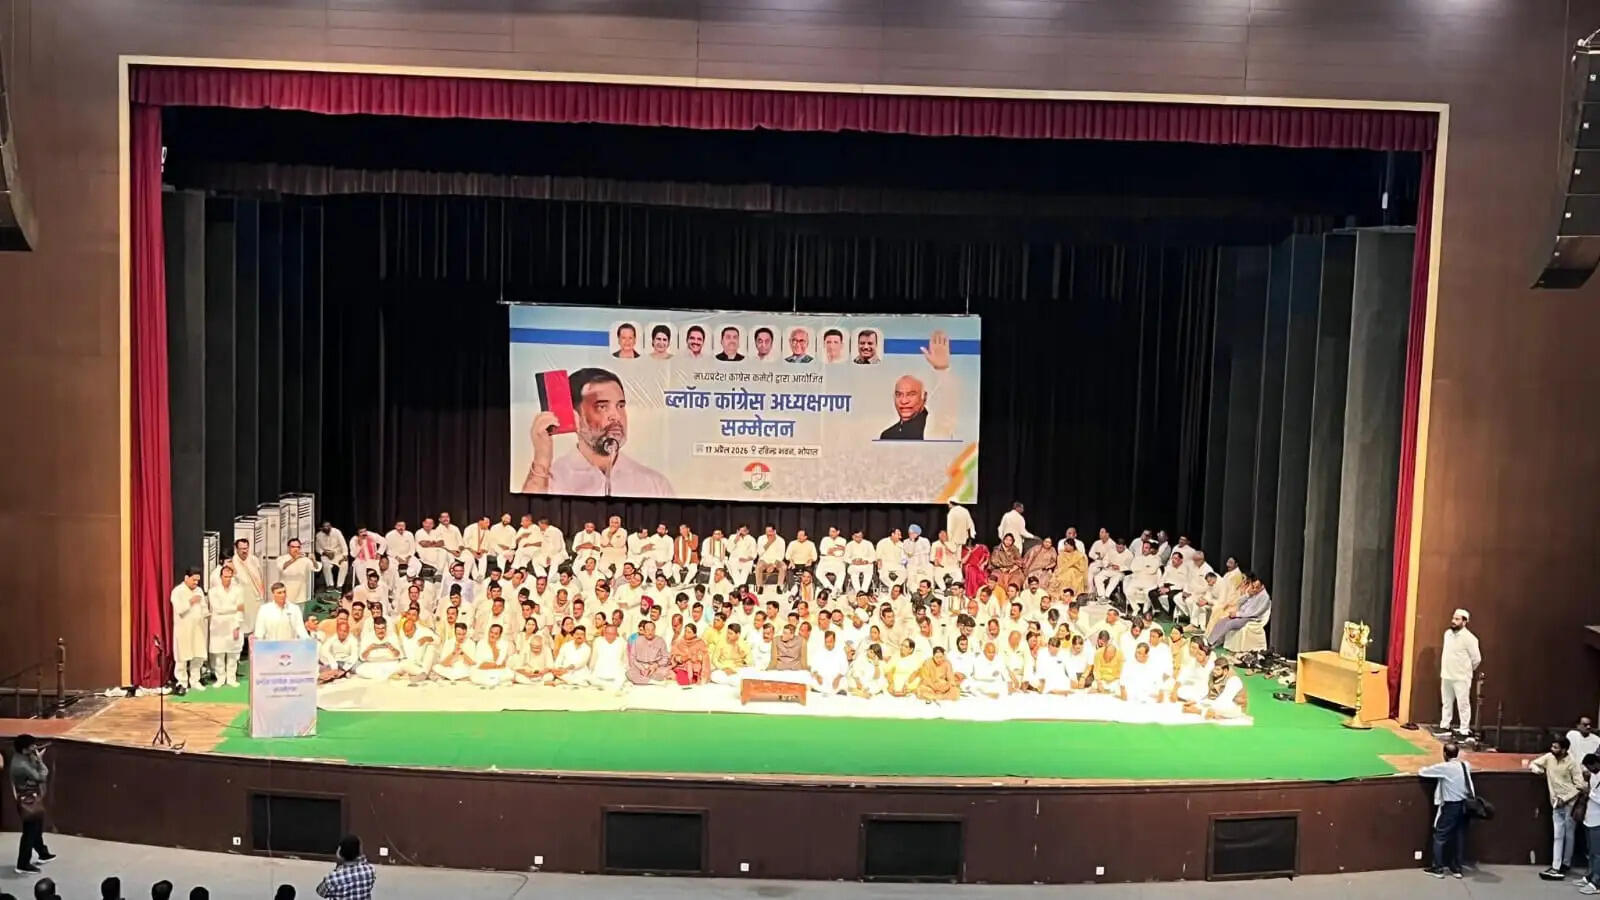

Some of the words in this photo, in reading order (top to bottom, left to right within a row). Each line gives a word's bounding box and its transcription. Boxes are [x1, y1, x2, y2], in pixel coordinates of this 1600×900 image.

[664, 386, 711, 410] ब्लॉक
[714, 387, 765, 411] कांग्रेस
[770, 394, 851, 413] अध्यक्षगण
[720, 414, 796, 437] सम्मेलन
